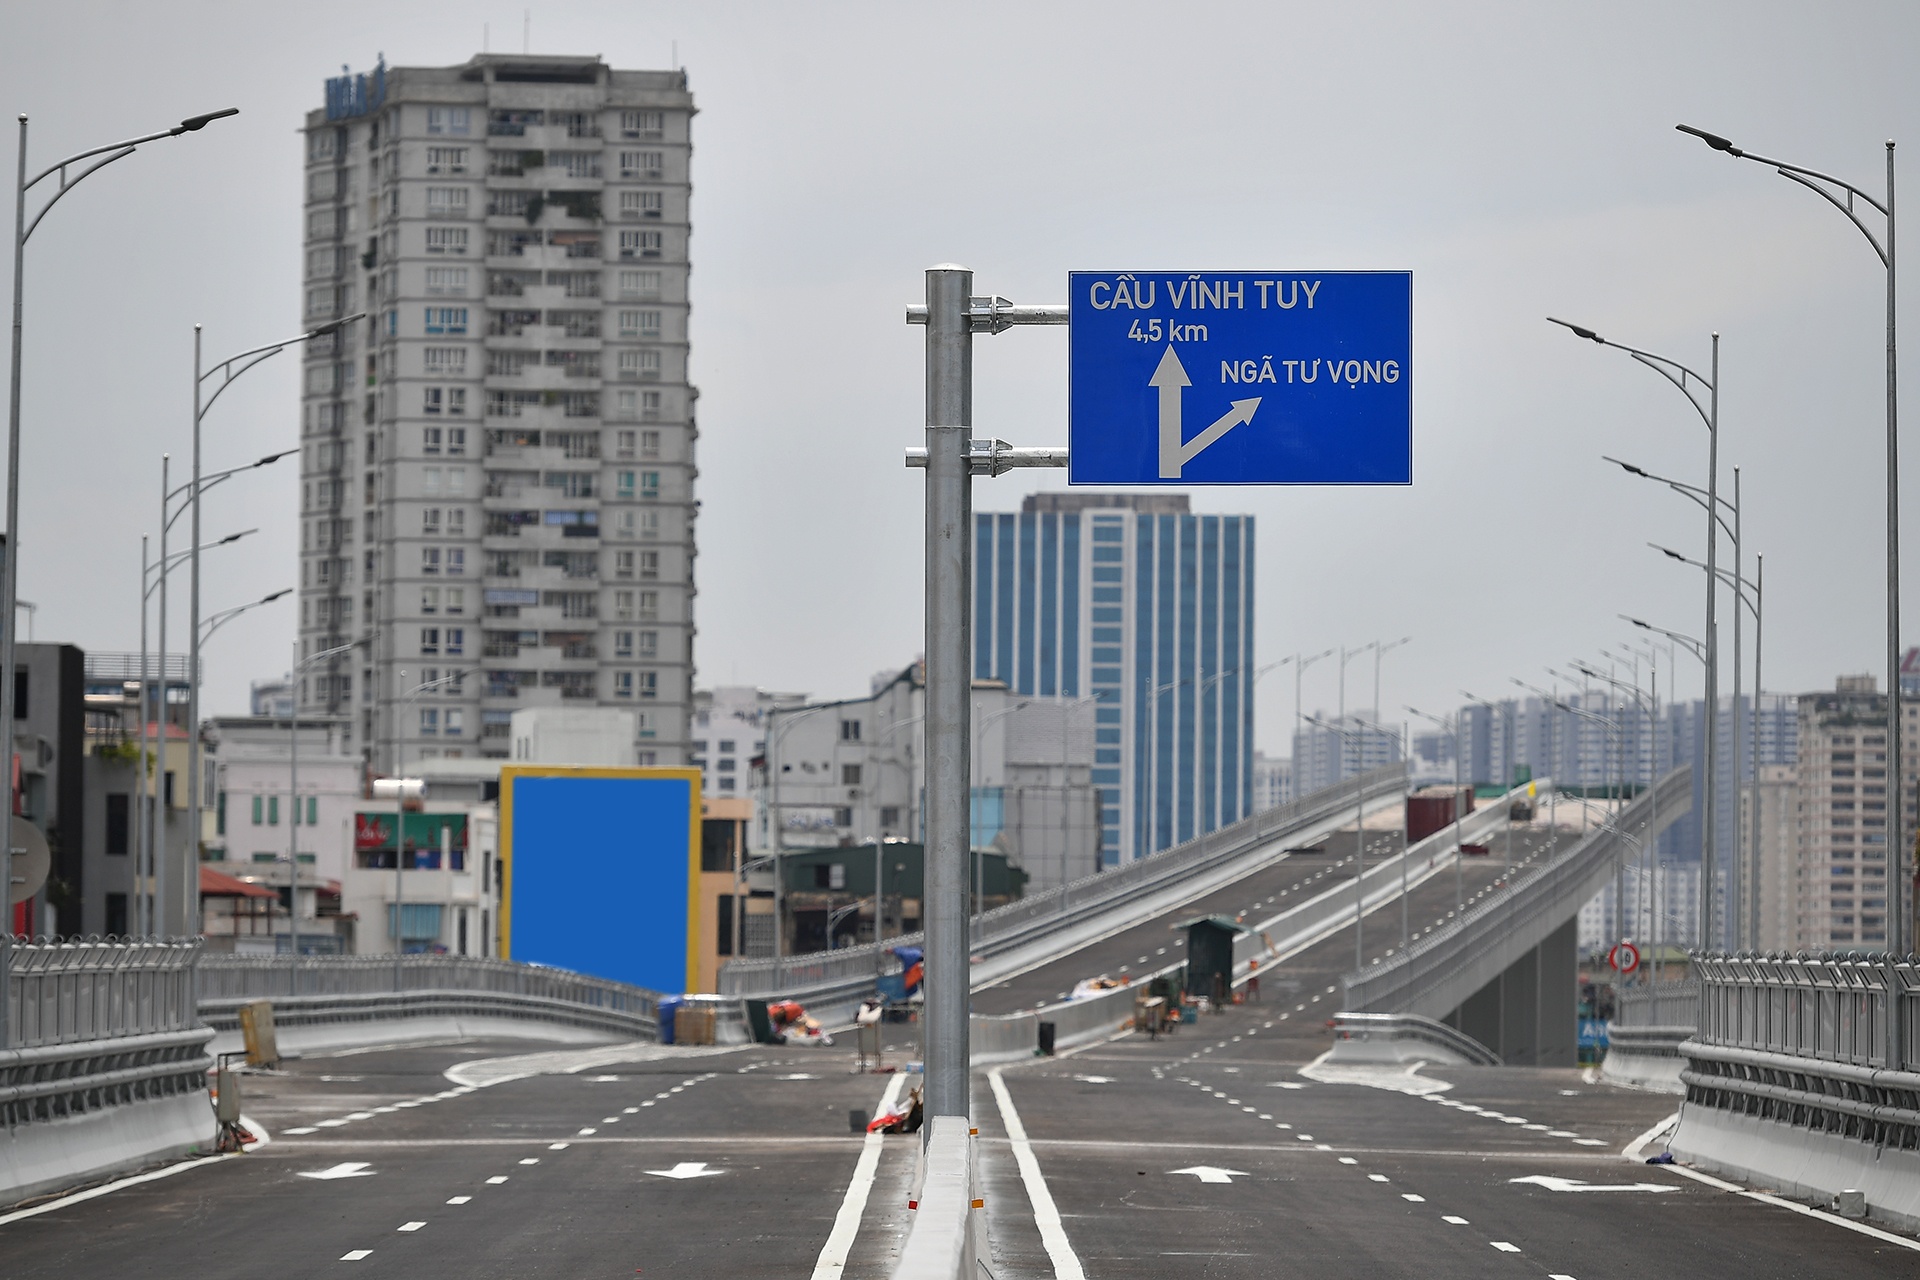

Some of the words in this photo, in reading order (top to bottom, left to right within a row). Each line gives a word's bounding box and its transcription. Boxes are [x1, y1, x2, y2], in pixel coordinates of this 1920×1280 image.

[1090, 274, 1156, 310] CẦU
[1167, 274, 1244, 310] VĨNH
[1254, 280, 1322, 310] TUY
[1128, 318, 1163, 344] 4,5
[1169, 318, 1208, 342] km
[1221, 354, 1277, 384] NGÃ
[1283, 357, 1321, 384] TƯ
[1327, 359, 1400, 390] VỌNG
